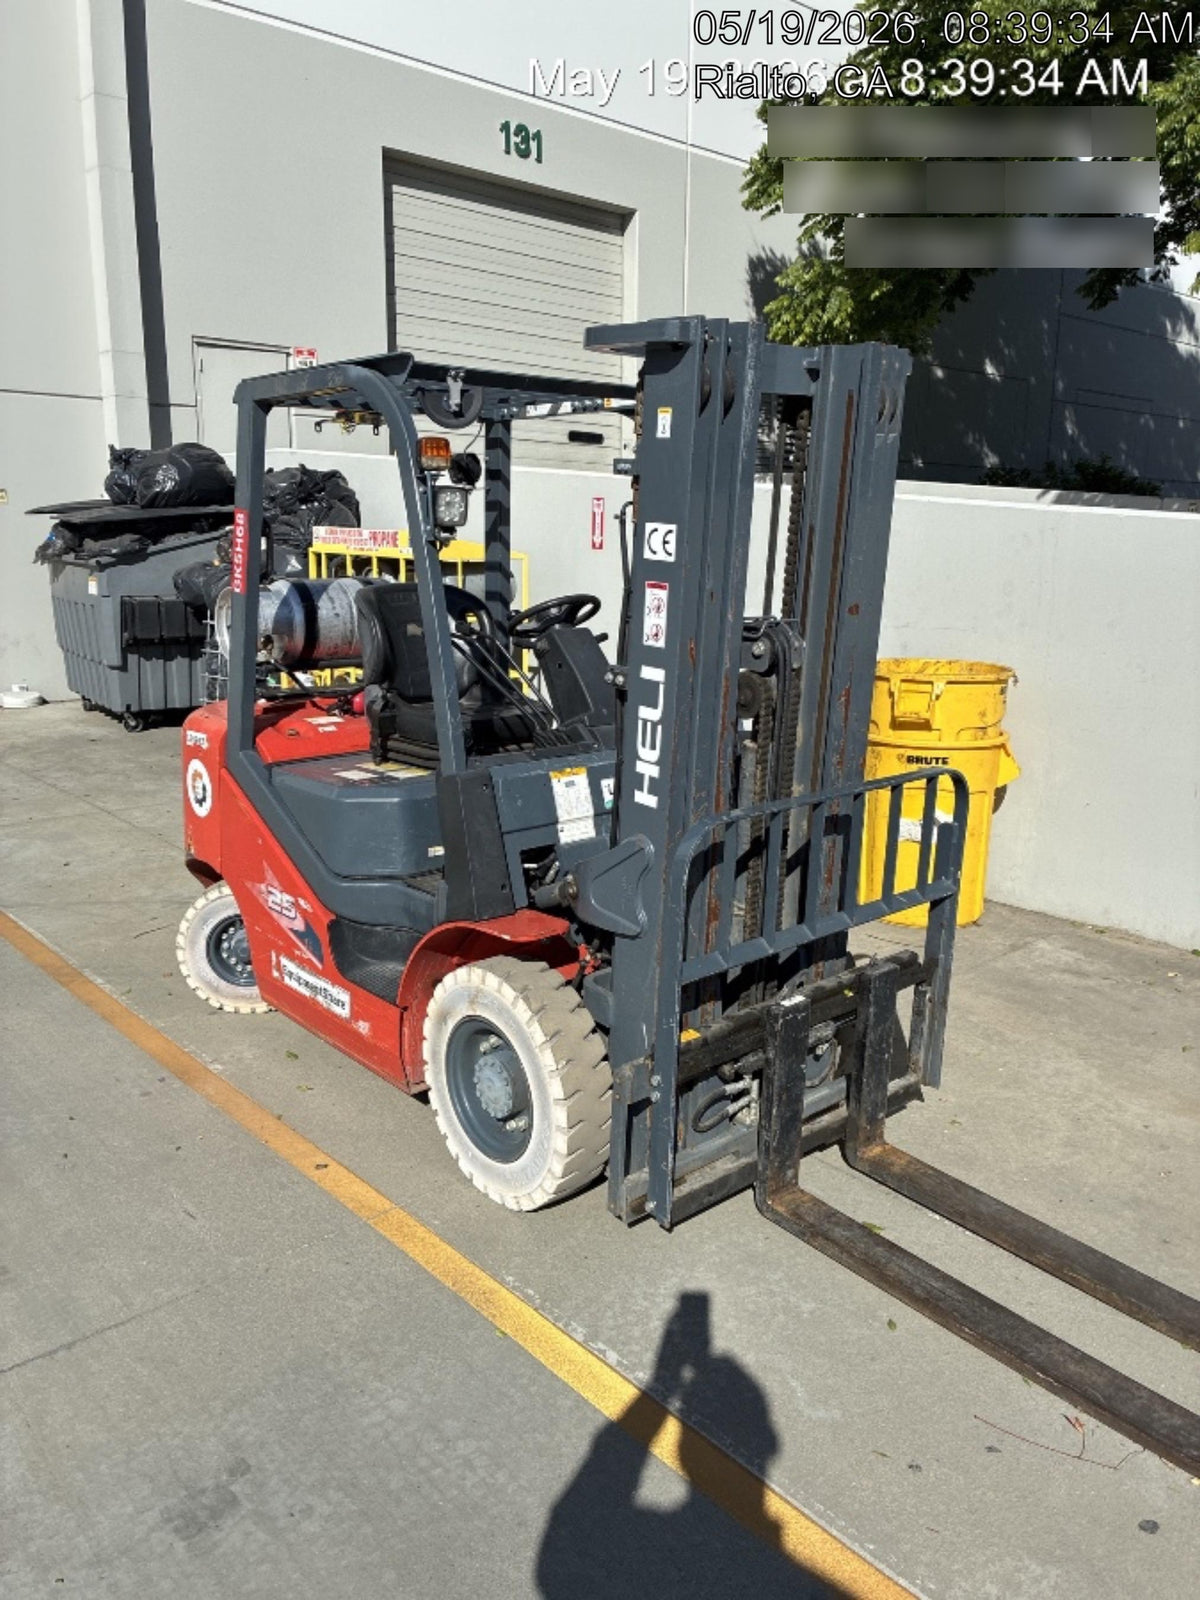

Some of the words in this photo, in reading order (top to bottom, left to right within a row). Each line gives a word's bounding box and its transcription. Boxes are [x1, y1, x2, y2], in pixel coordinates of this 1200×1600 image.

[499, 120, 543, 164] 131
[646, 527, 674, 557] CE
[634, 664, 666, 810] HELI
[906, 755, 950, 766] BRUTE
[265, 884, 298, 920] 25
